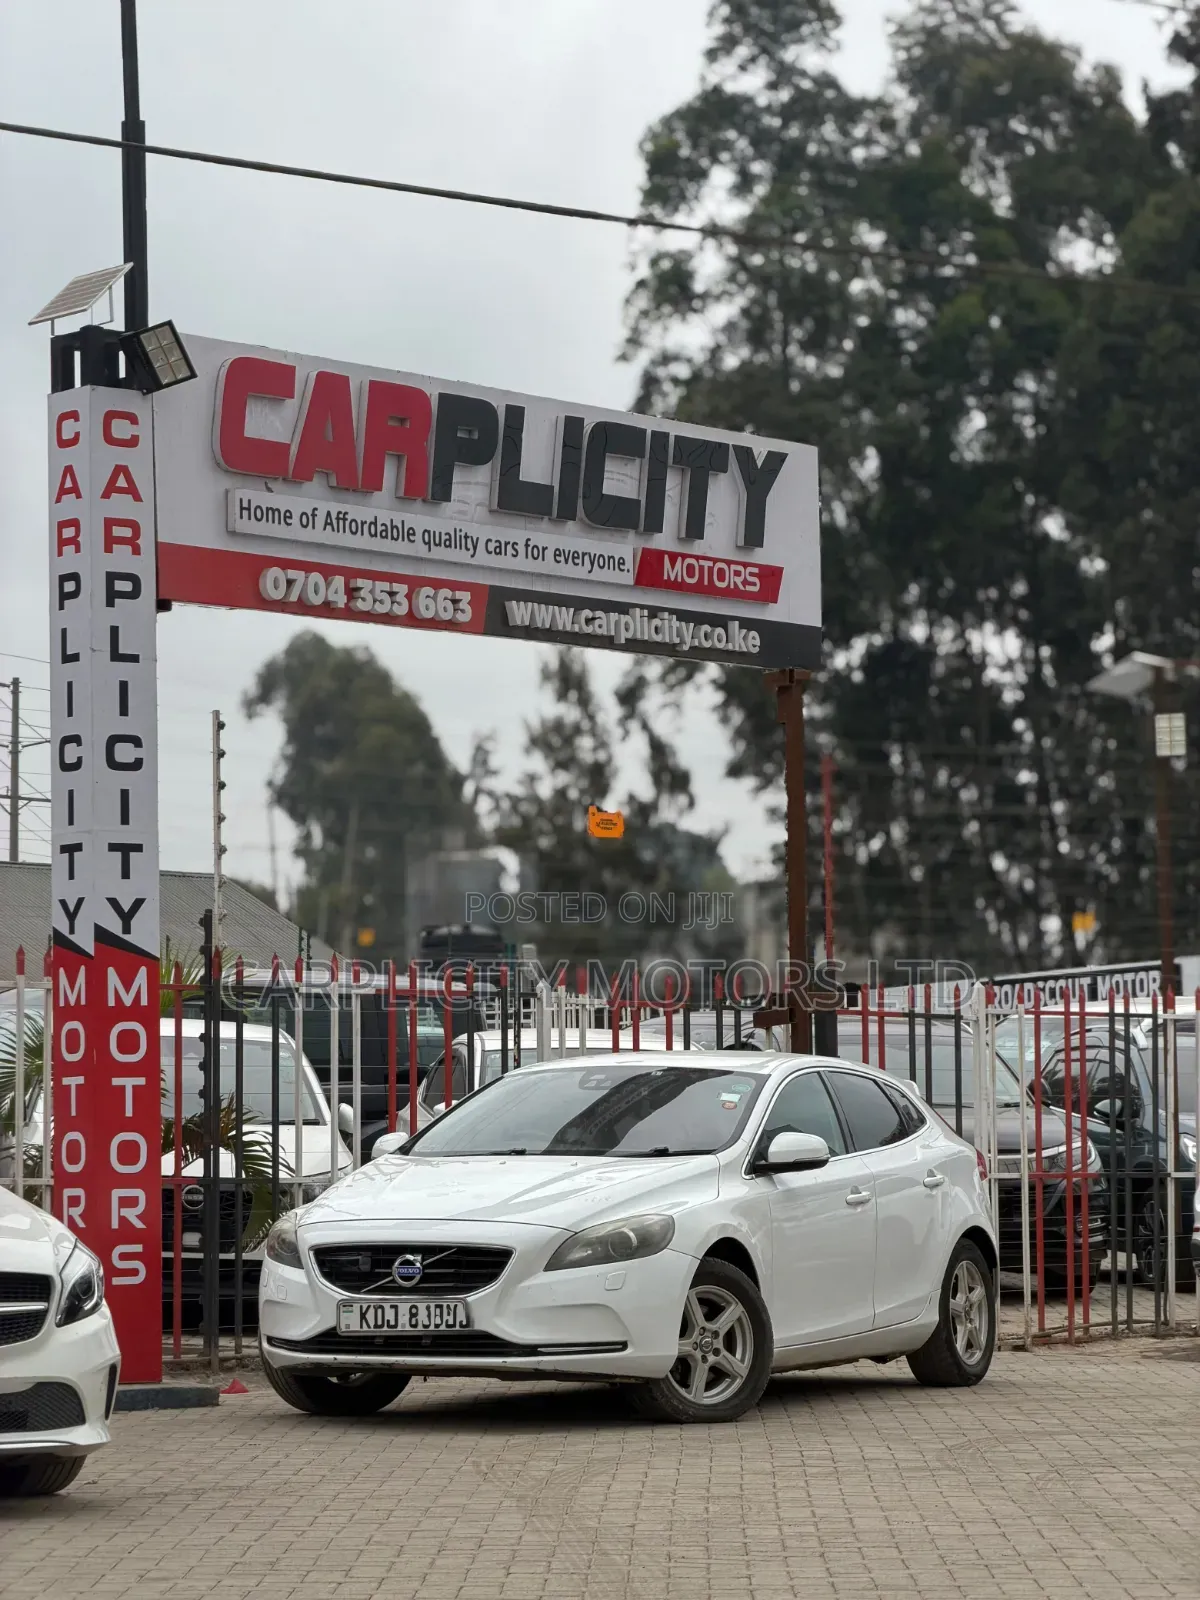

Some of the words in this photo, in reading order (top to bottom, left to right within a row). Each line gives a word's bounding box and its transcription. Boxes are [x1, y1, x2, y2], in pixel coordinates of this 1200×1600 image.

[216, 356, 788, 549] CARPLICITY
[238, 497, 293, 526] Home
[299, 507, 318, 530] of
[323, 510, 416, 543] Affordable
[421, 527, 479, 558] quality
[484, 537, 519, 557] cars
[524, 538, 548, 561] for
[553, 547, 631, 574] everyone.
[663, 554, 761, 592] MOTORS
[259, 567, 347, 608] 0704
[350, 578, 409, 616] 353
[412, 586, 472, 623] 663
[505, 600, 761, 653] www.carplicity.co.ke
[55, 409, 86, 935] CARPLICITY
[100, 409, 147, 935] CARPLICITY
[107, 966, 147, 1285] MOTORS
[360, 1304, 399, 1329] KDJ
